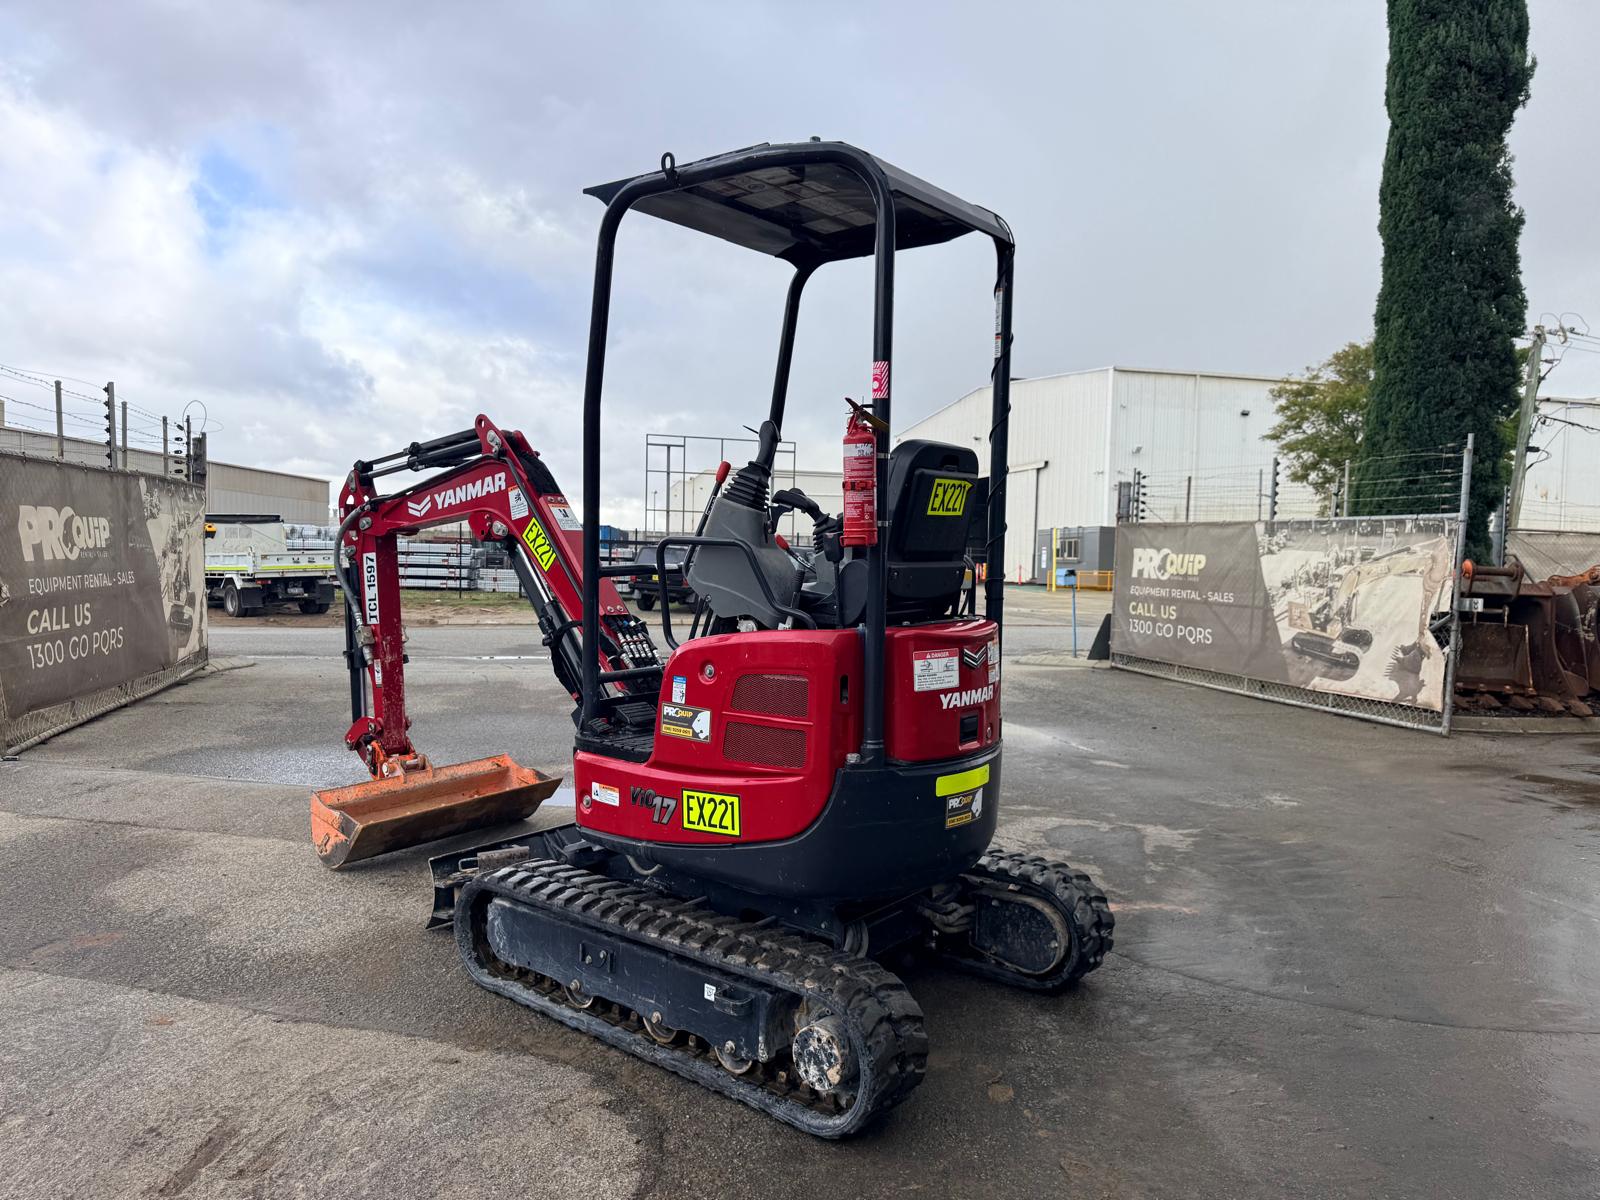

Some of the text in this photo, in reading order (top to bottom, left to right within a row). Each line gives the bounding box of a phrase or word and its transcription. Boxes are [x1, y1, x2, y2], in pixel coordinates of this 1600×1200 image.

[434, 471, 507, 510] YANMAR
[931, 483, 966, 512] EX221
[526, 522, 554, 567] EX221
[29, 575, 82, 596] EQUIPMENT
[84, 575, 112, 589] RENTAL
[117, 571, 135, 585] SALES
[366, 556, 376, 590] 1597
[1130, 586, 1170, 598] EQUIPMENT
[1172, 589, 1201, 600] RENTAL
[1208, 592, 1234, 603] SALES
[27, 603, 92, 635] CALL US
[1129, 601, 1177, 620] CALL US
[1129, 619, 1213, 644] 1300 GO PQRS
[27, 627, 124, 670] 1300 GO PQRS
[940, 685, 993, 709] YANMAR
[652, 794, 677, 825] 17
[686, 794, 735, 831] EX221
